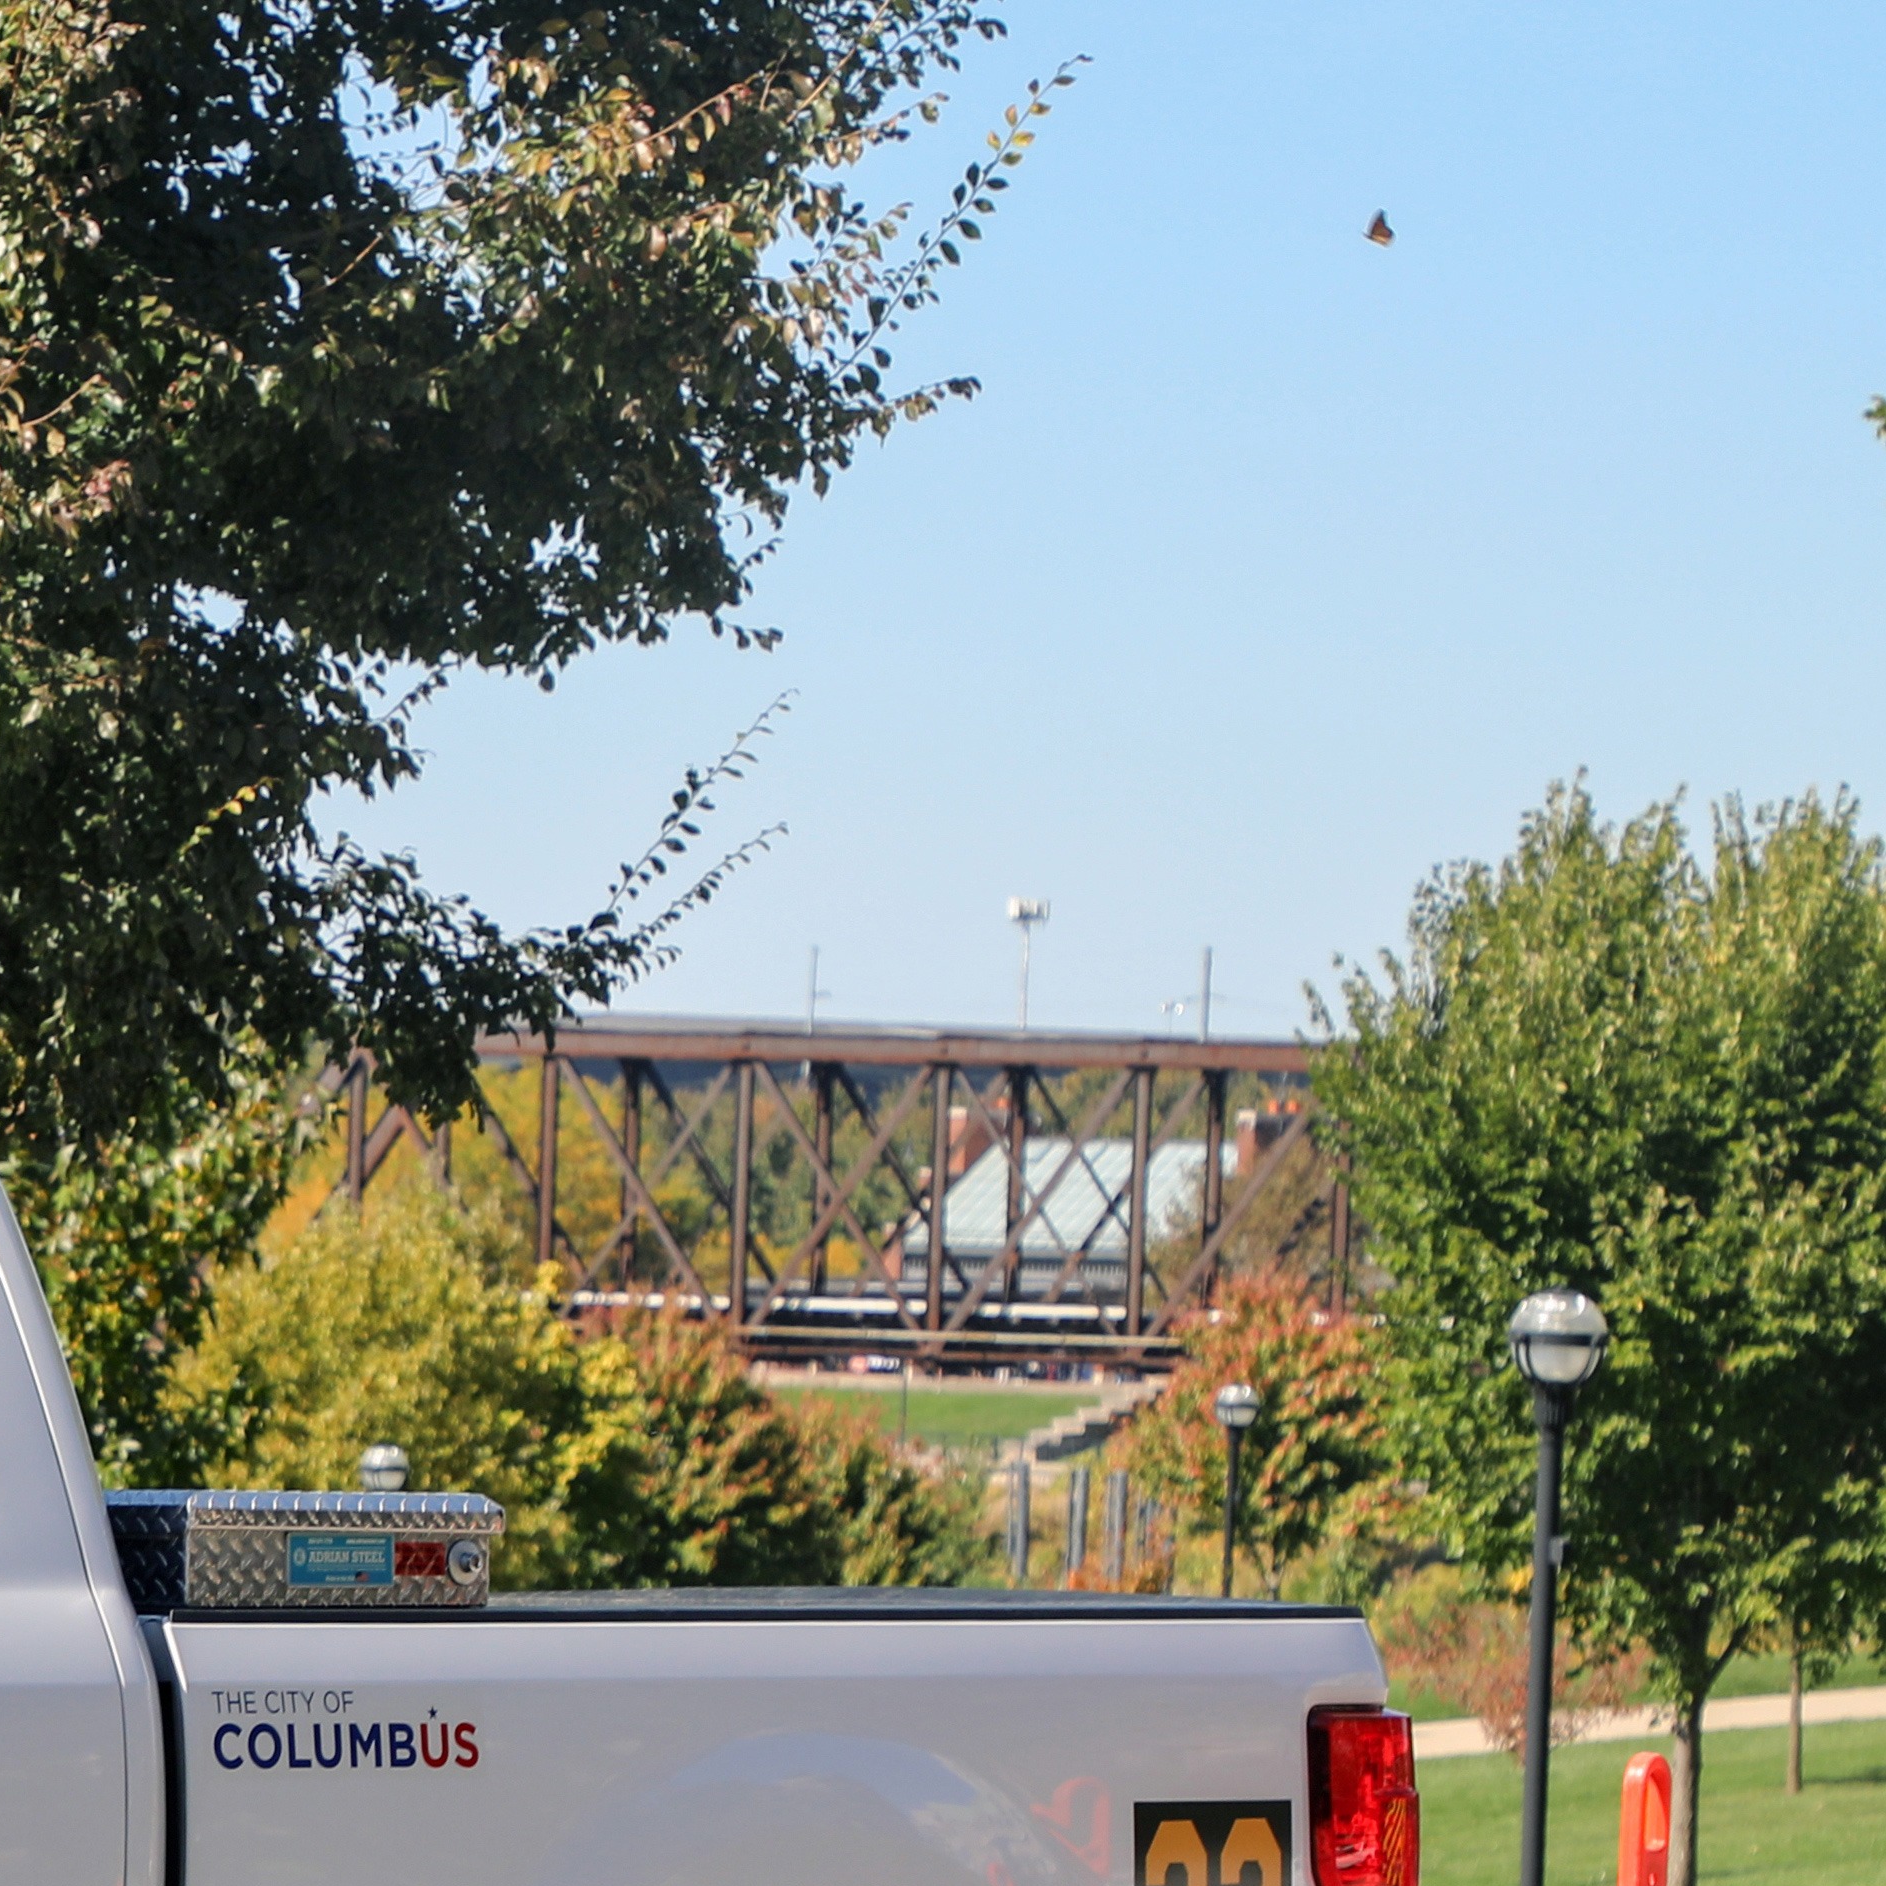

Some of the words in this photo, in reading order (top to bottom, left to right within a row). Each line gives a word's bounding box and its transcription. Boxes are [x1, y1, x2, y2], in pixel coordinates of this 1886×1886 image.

[308, 1550, 349, 1564] ADRIAN
[350, 1550, 386, 1564] STEEL
[211, 1691, 257, 1714] THE
[264, 1690, 315, 1714] CITY
[323, 1690, 354, 1714] OF
[213, 1721, 479, 1770] COLUMBUS
